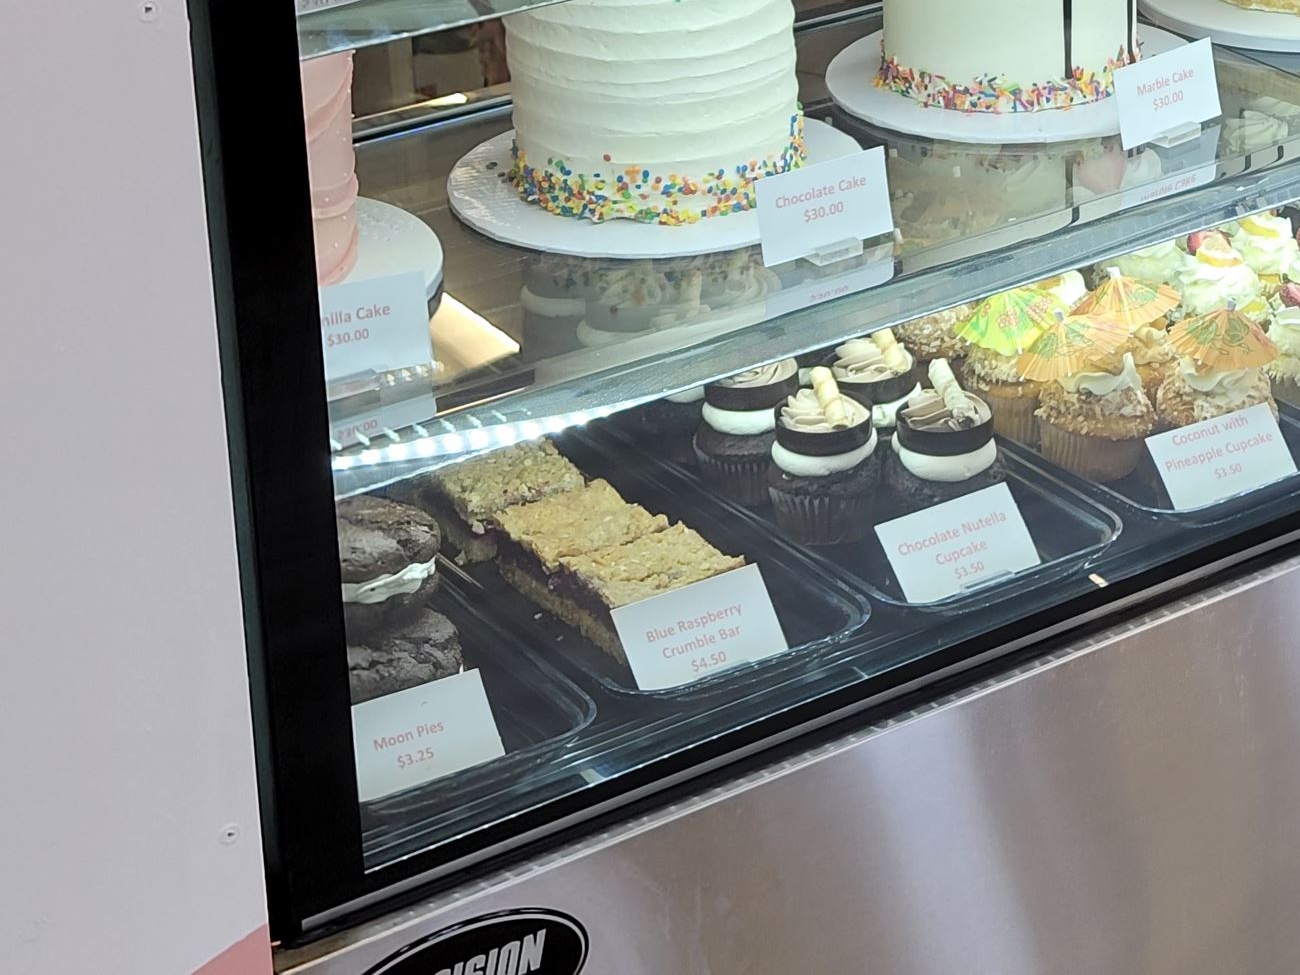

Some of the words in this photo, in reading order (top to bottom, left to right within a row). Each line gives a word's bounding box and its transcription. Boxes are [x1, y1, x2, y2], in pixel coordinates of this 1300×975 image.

[1137, 78, 1171, 97] Marble
[1172, 67, 1195, 84] Cake
[1153, 90, 1184, 111] $30.00
[775, 184, 835, 209] Chocolate
[838, 175, 867, 192] Cake
[804, 201, 844, 223] $30.00
[322, 312, 352, 327] nilla
[356, 304, 391, 321] Cake
[327, 329, 370, 347] $30.00
[1172, 425, 1221, 447] Coconut
[1222, 415, 1249, 432] with
[1164, 447, 1224, 473] Pineapple
[1225, 431, 1273, 454] Cupcake
[1214, 463, 1242, 480] $3.50
[897, 527, 961, 556] Chocolate
[961, 511, 1008, 535] Nutella
[935, 540, 988, 565] Cupcake
[954, 561, 985, 580] $3.50
[646, 624, 676, 643] Blue
[677, 604, 742, 632] Raspberry
[662, 634, 716, 659] Crumble
[719, 624, 741, 640] Bar
[691, 650, 727, 673] $4.50
[373, 731, 414, 751] Moon
[416, 721, 445, 738] Pies
[397, 747, 434, 769] $3.25
